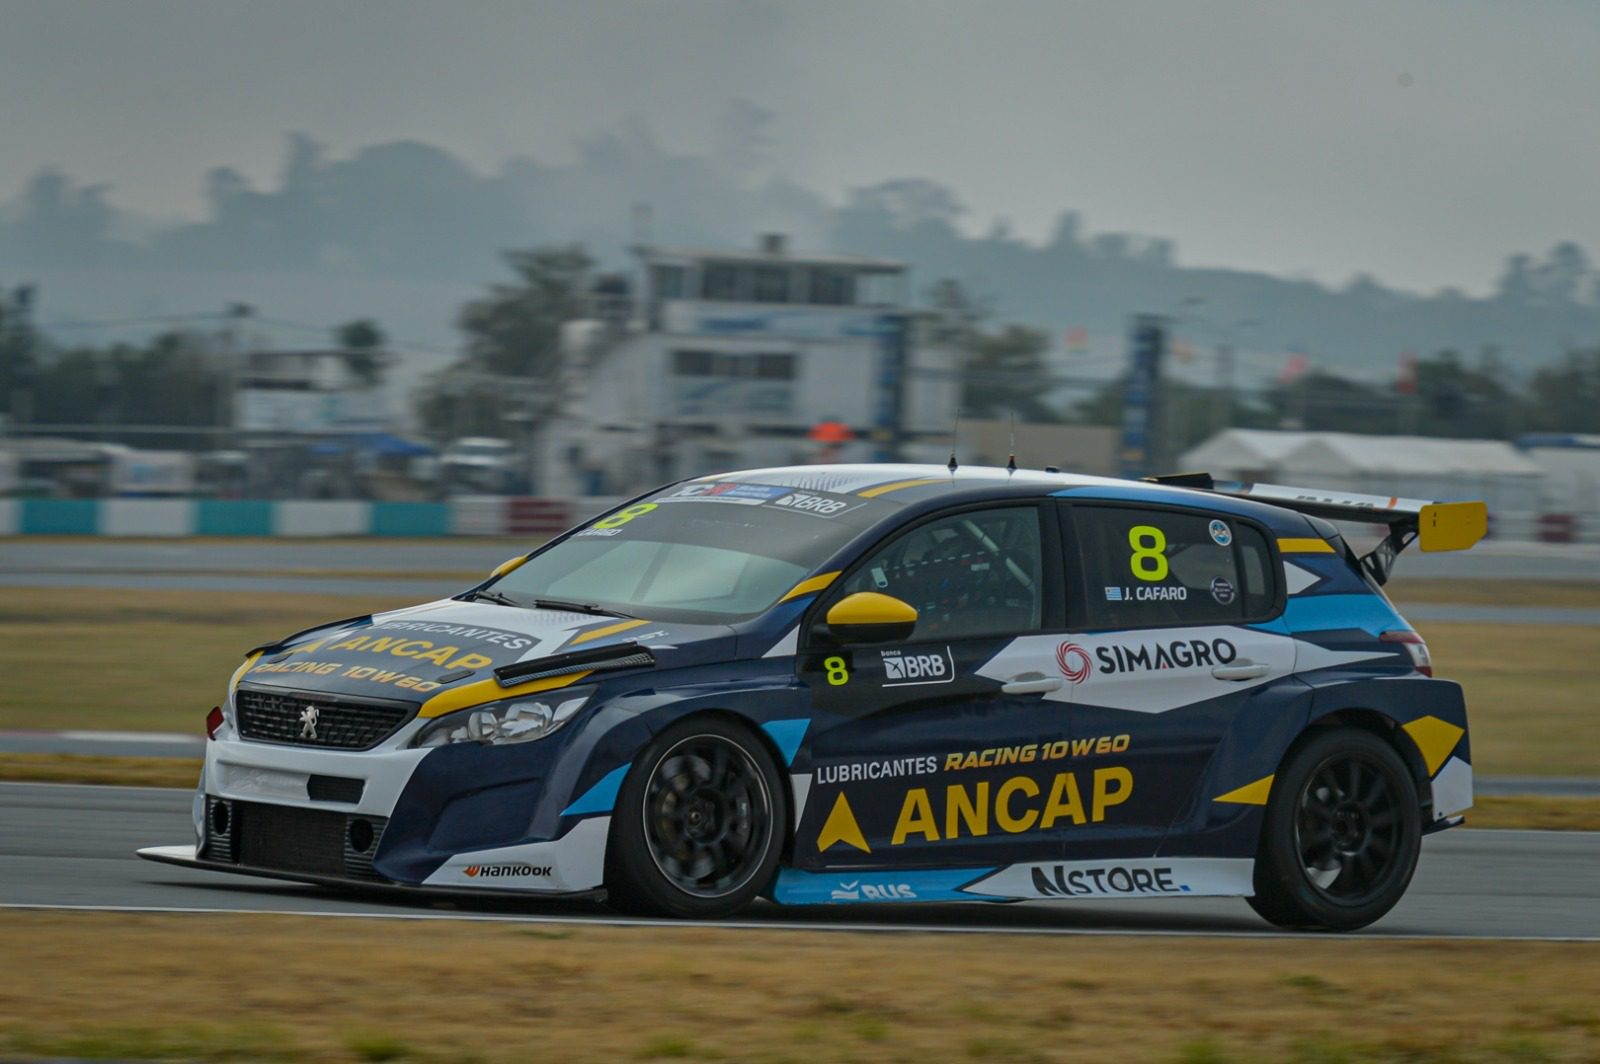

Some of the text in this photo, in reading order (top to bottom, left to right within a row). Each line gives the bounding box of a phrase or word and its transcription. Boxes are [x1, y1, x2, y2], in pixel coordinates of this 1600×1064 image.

[593, 503, 658, 529] 8
[796, 494, 848, 514] BRB
[1128, 525, 1169, 581] 8
[1124, 586, 1188, 601] J. CAFARO
[326, 636, 493, 669] ANCAP
[905, 654, 946, 678] BRB
[1095, 638, 1237, 674] SIMAGRO
[247, 661, 443, 693] RACING 10W60
[824, 656, 849, 686] 8
[817, 756, 938, 784] LUBRICANTES
[943, 744, 1039, 772] RACING
[891, 766, 1134, 846] ANCAP
